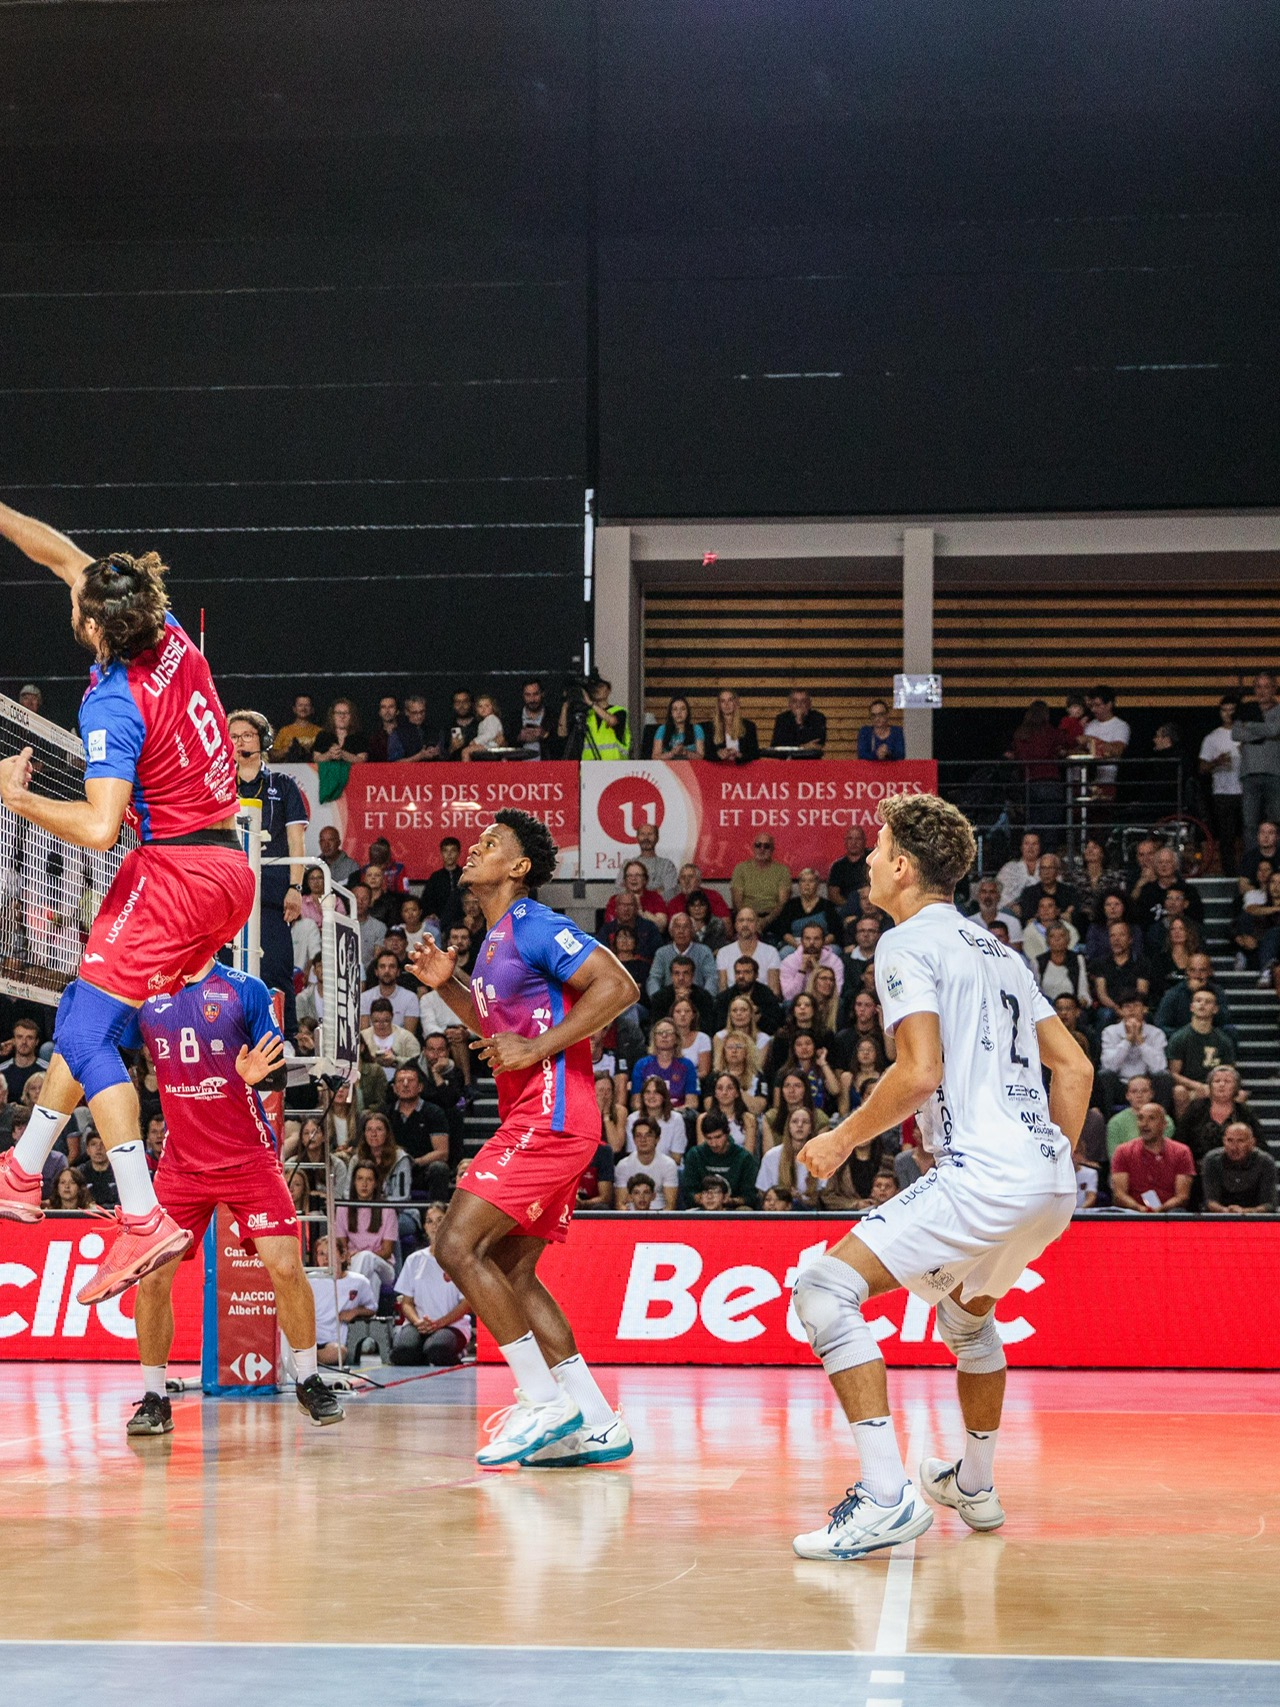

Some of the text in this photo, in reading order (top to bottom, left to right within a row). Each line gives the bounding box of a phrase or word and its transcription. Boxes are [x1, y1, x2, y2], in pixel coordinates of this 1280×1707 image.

[186, 690, 222, 758] 6
[366, 783, 564, 802] PALAIS DES SPORTS
[721, 782, 789, 800] PALAIS
[797, 782, 836, 800] DES
[364, 811, 388, 828] ET
[395, 811, 433, 829] DES
[720, 810, 740, 827] ET
[751, 809, 790, 827] DES
[105, 890, 140, 944] LUCCIONI
[887, 980, 903, 992] LBM
[472, 976, 489, 1019] 16
[1000, 989, 1029, 1068] 2
[180, 1027, 200, 1064] 8
[542, 1058, 553, 1116] ORSICA
[230, 1291, 275, 1302] AJACCIO
[228, 1305, 260, 1316] Albert
